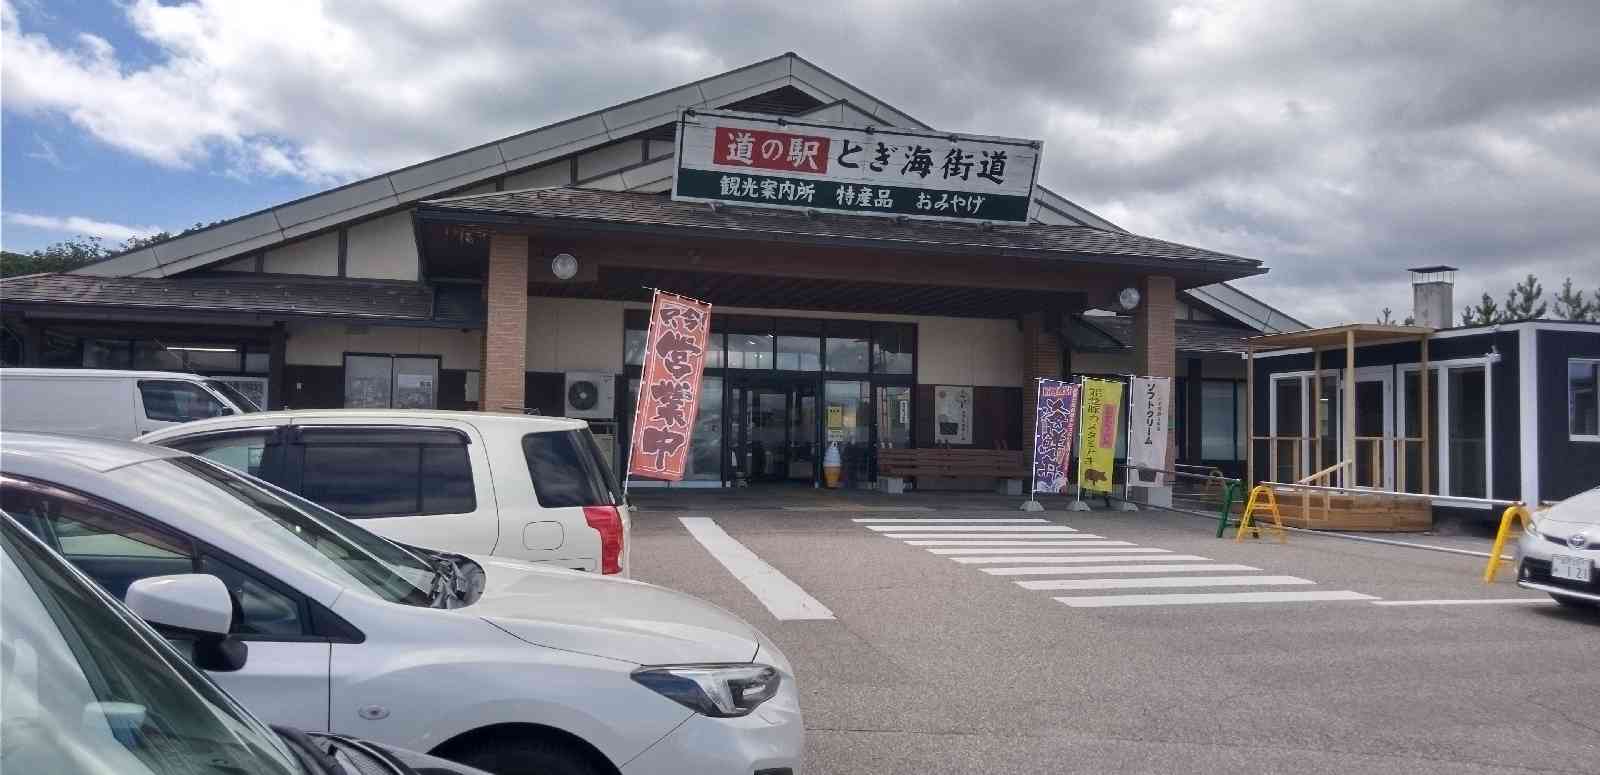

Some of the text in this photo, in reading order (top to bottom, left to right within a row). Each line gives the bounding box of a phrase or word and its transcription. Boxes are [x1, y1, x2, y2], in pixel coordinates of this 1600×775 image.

[725, 132, 1008, 184] 道の駅 とぎ海街道
[719, 174, 985, 215] 観光案内所 特産品 おみやげ
[1144, 383, 1157, 446] ソフトクリーム
